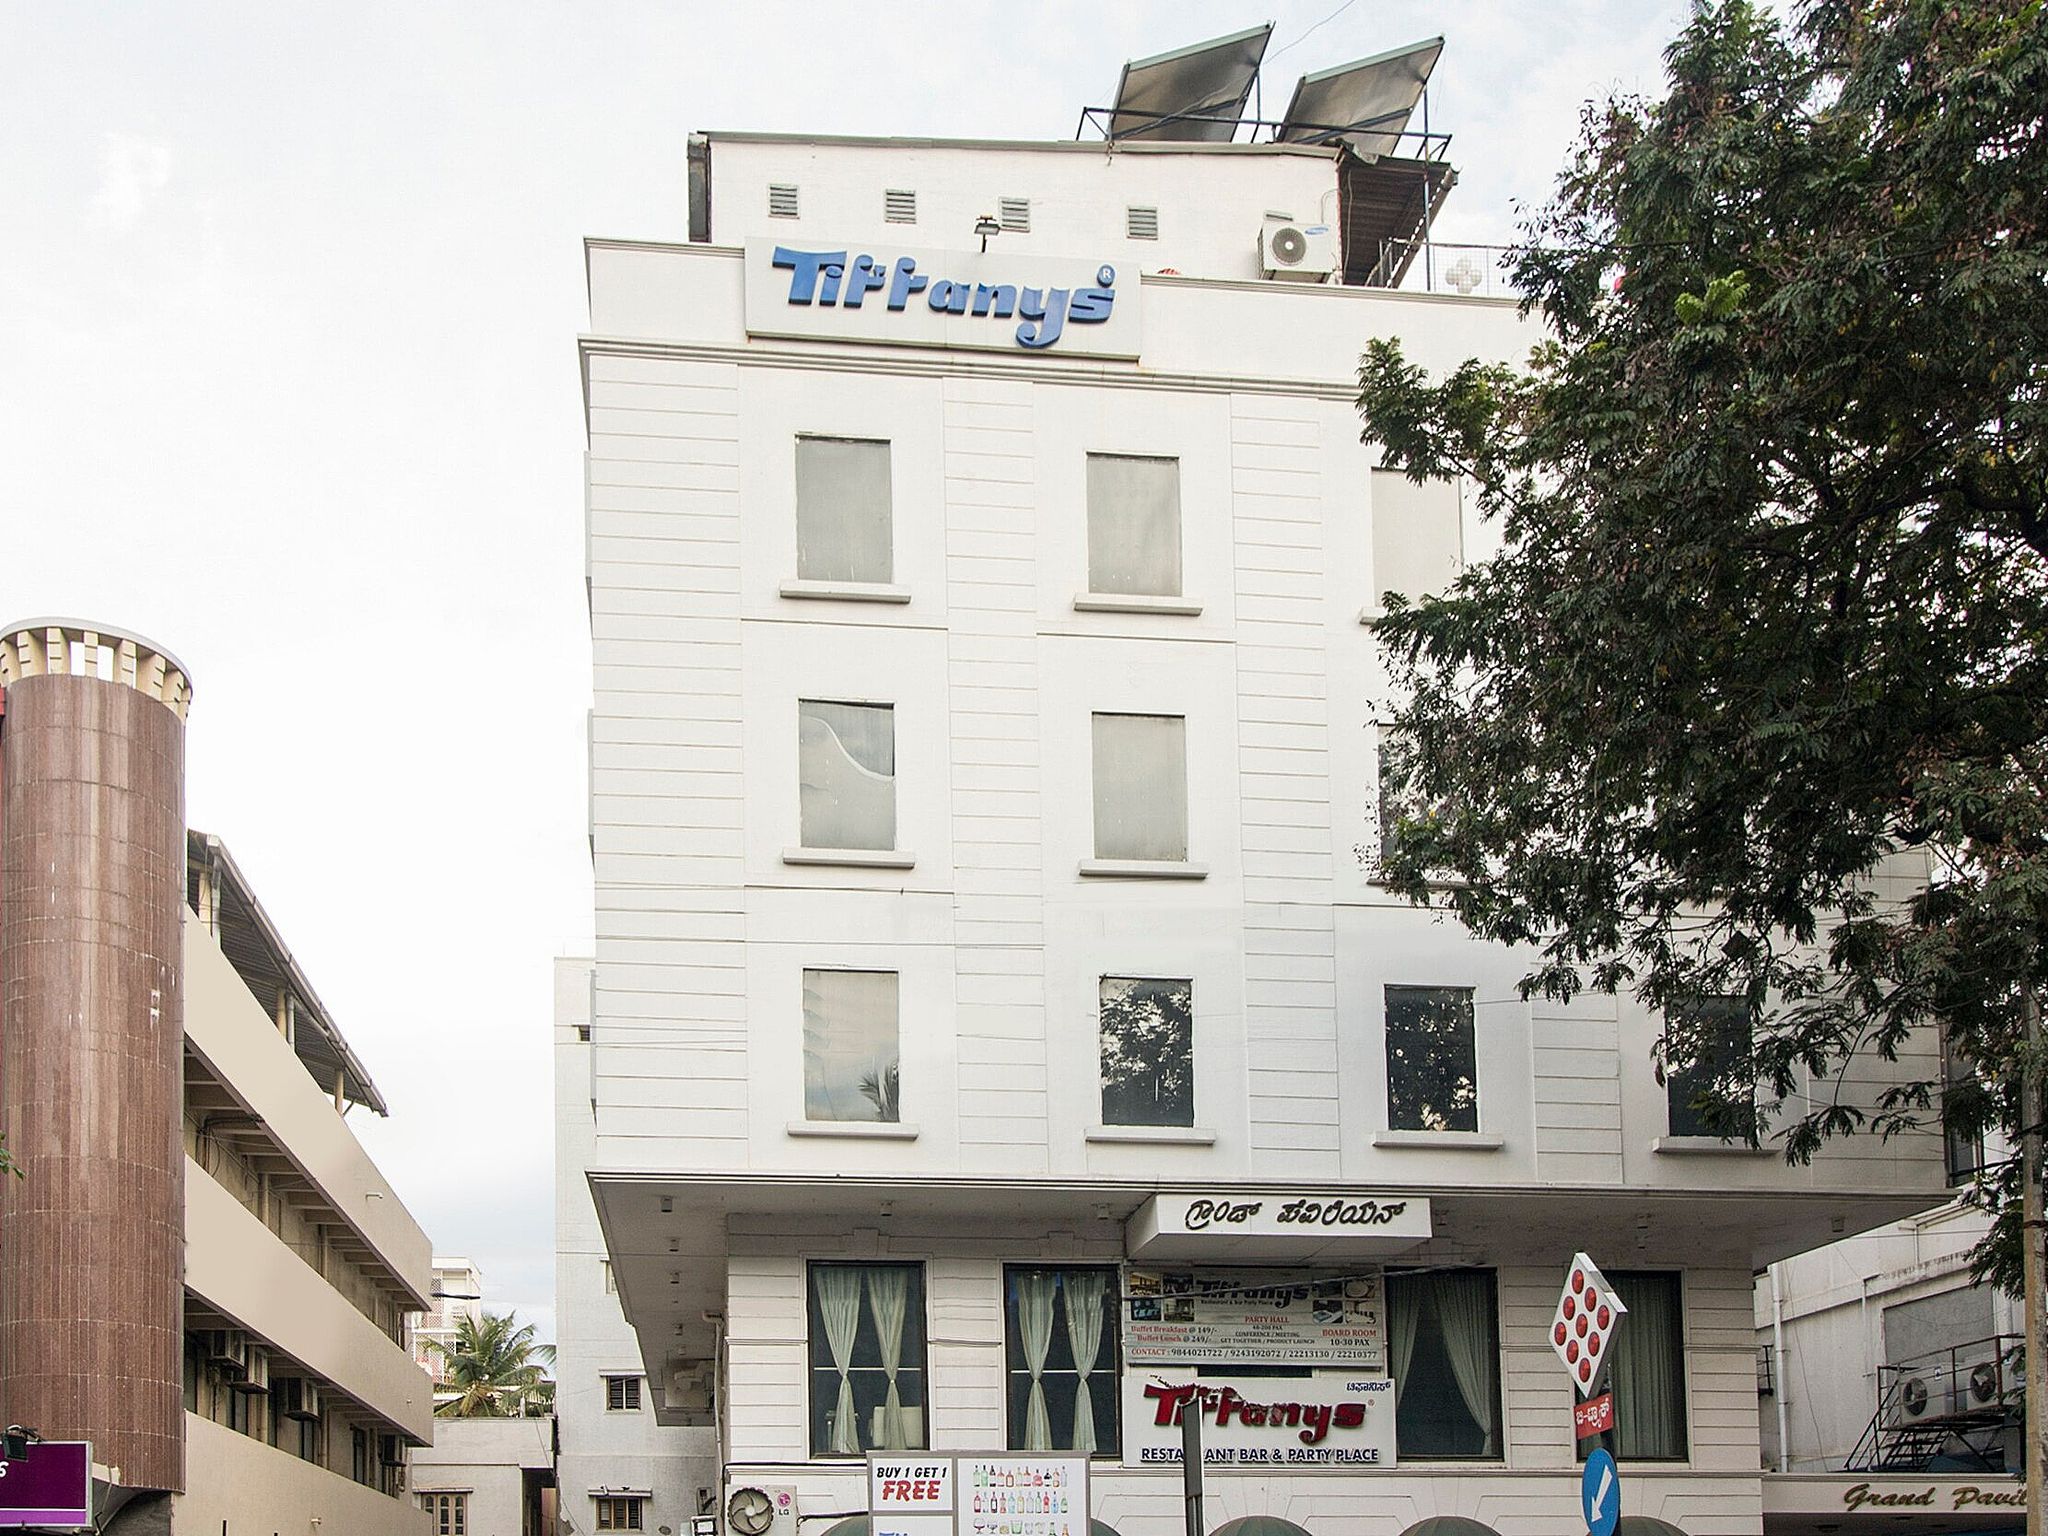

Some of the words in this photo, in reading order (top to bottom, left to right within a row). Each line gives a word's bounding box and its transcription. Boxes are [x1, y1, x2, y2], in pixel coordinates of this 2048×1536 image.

[1323, 1329, 1350, 1337] BOARD
[1352, 1329, 1377, 1337] ROOM
[1141, 1449, 1236, 1461] RESTAANT
[1239, 1449, 1270, 1461] BAR
[1273, 1450, 1281, 1461] &
[1288, 1450, 1331, 1461] PARTY
[1335, 1450, 1378, 1461] PLACE
[877, 1467, 901, 1478] BUY
[905, 1467, 910, 1478] 1
[914, 1467, 938, 1478] GET
[941, 1467, 947, 1478] 1
[882, 1480, 941, 1501] FREE
[1844, 1483, 1936, 1511] Grand
